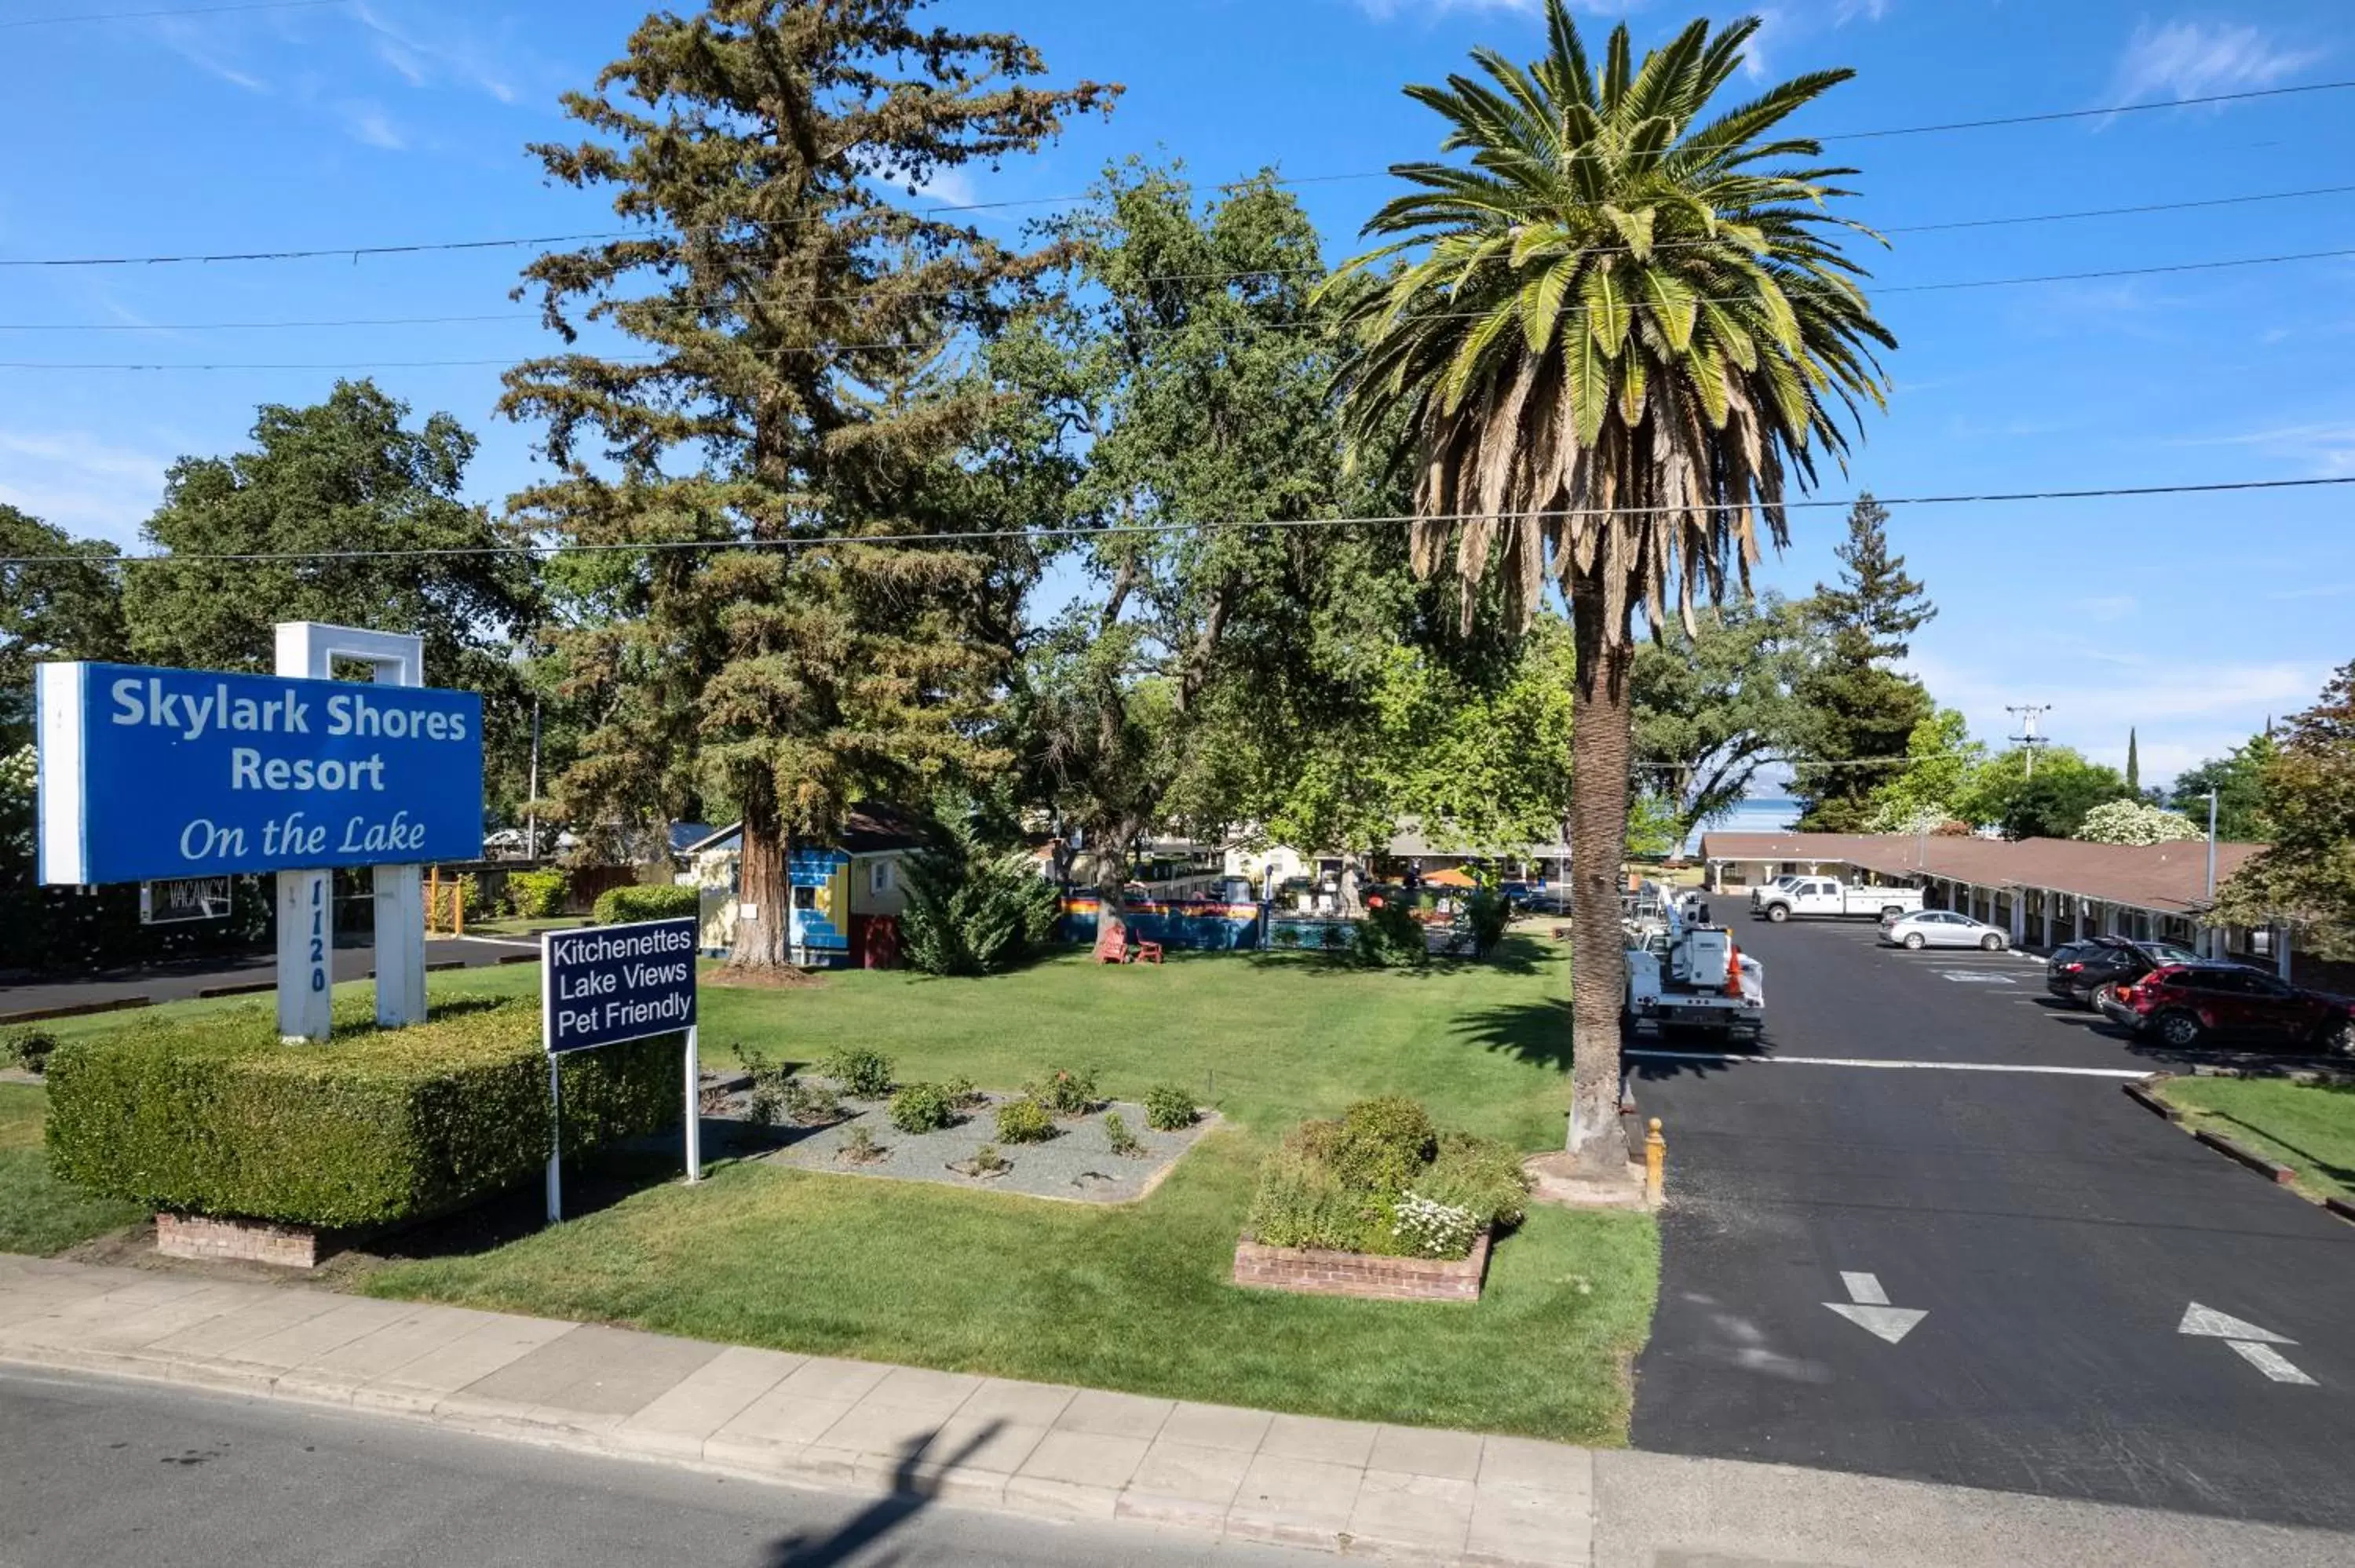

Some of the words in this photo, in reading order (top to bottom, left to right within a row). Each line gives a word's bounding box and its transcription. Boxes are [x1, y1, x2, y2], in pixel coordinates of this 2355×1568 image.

[111, 677, 310, 740] Skylark
[327, 695, 466, 740] Shores
[232, 747, 385, 790] Resort
[180, 819, 248, 860] On
[263, 811, 327, 855] the
[338, 811, 425, 852] Lake
[310, 879, 325, 992] 1120
[553, 929, 692, 967] Kitchenettes
[560, 970, 616, 1001] Lake
[623, 962, 687, 989] Views
[558, 1007, 598, 1037] Pet
[605, 991, 692, 1028] Friendly
